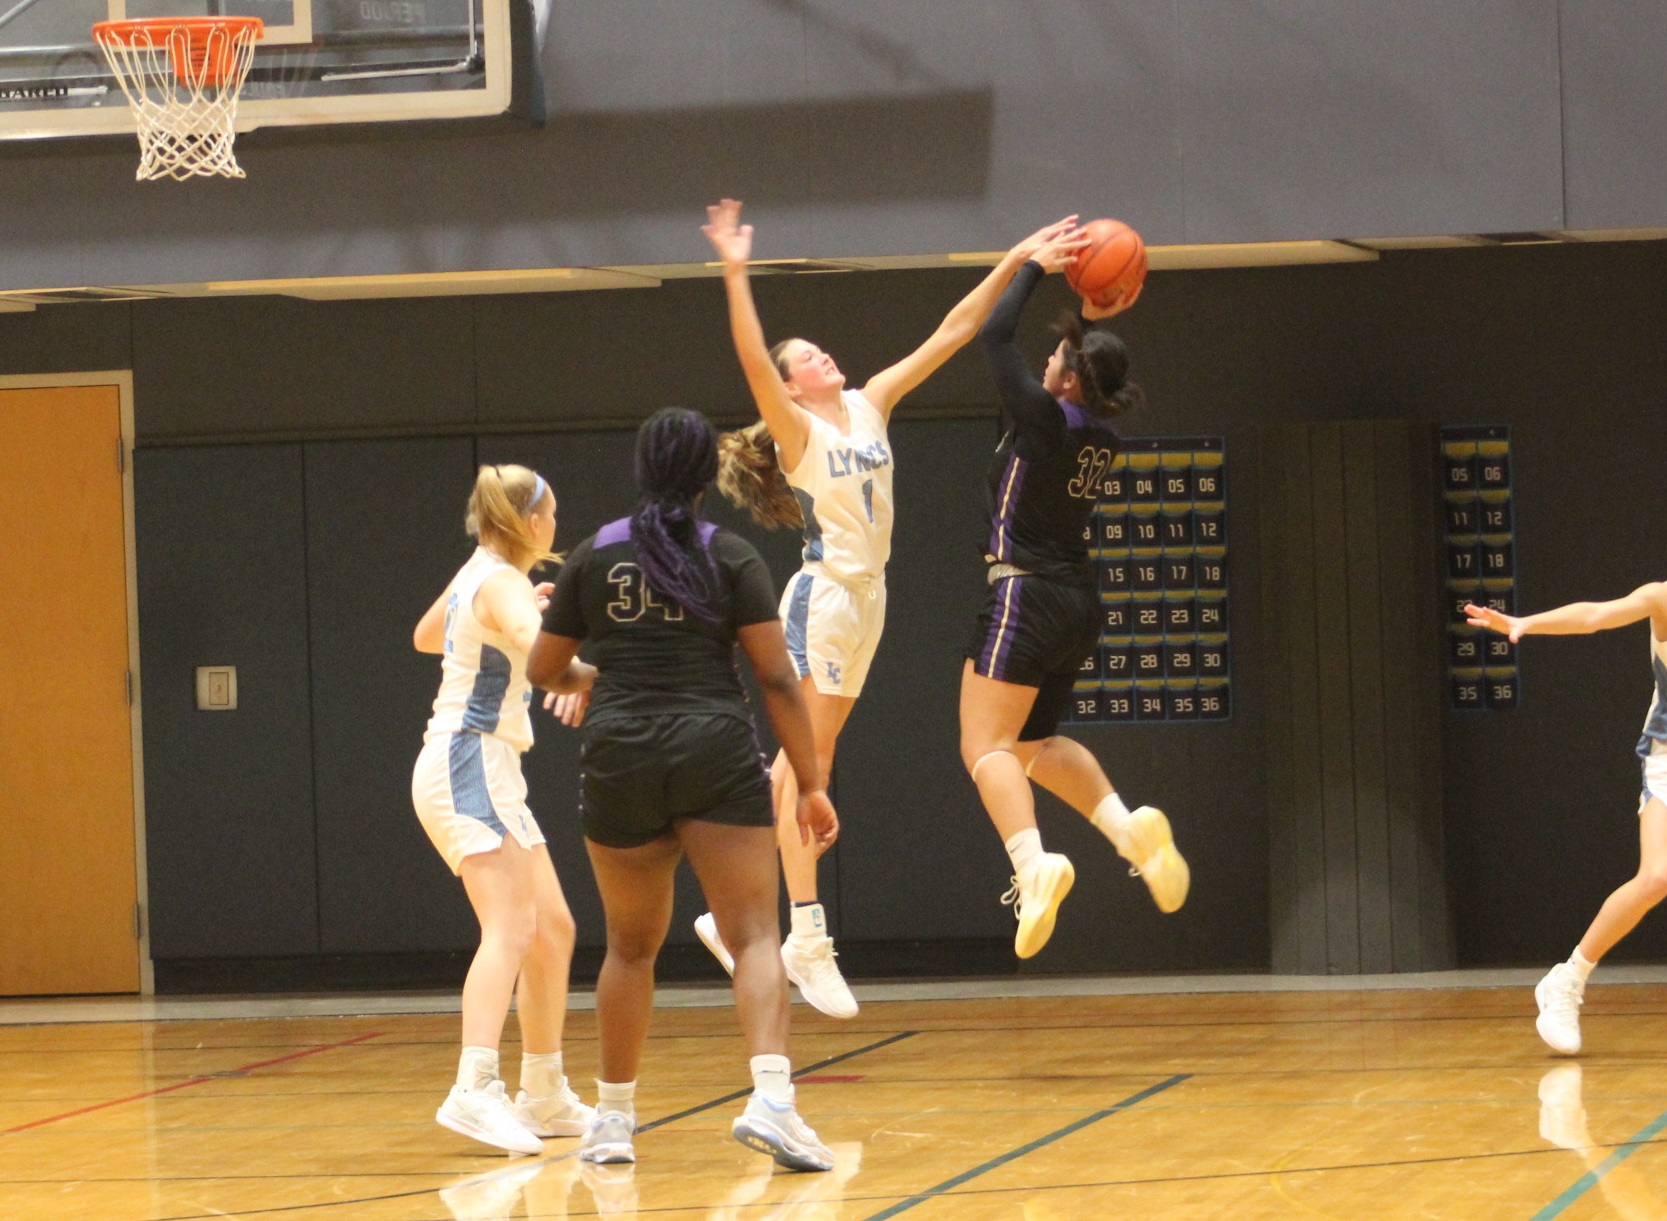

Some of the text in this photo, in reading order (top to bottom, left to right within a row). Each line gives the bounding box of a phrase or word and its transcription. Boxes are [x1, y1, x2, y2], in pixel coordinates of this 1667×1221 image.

[1067, 445, 1111, 499] 32
[1451, 466, 1501, 482] 05 06
[1104, 477, 1216, 496] 03 04 05 06
[861, 478, 874, 524] 1
[1453, 511, 1503, 526] 11 12
[1106, 524, 1123, 539] 09
[1138, 524, 1155, 539] 10
[1169, 523, 1184, 538] 11
[1201, 522, 1217, 537] 12
[1456, 553, 1504, 568] 17 18
[1108, 565, 1220, 583] 15 16 17 18
[1107, 608, 1219, 626] 21 22 23 24
[1457, 641, 1509, 656] 29 30
[1109, 655, 1127, 670] 27
[1140, 654, 1158, 669] 28
[1173, 653, 1191, 667] 29
[1203, 653, 1221, 668] 30
[1459, 684, 1512, 700] 35 36
[1077, 697, 1220, 714] 32 33 34 35 36
